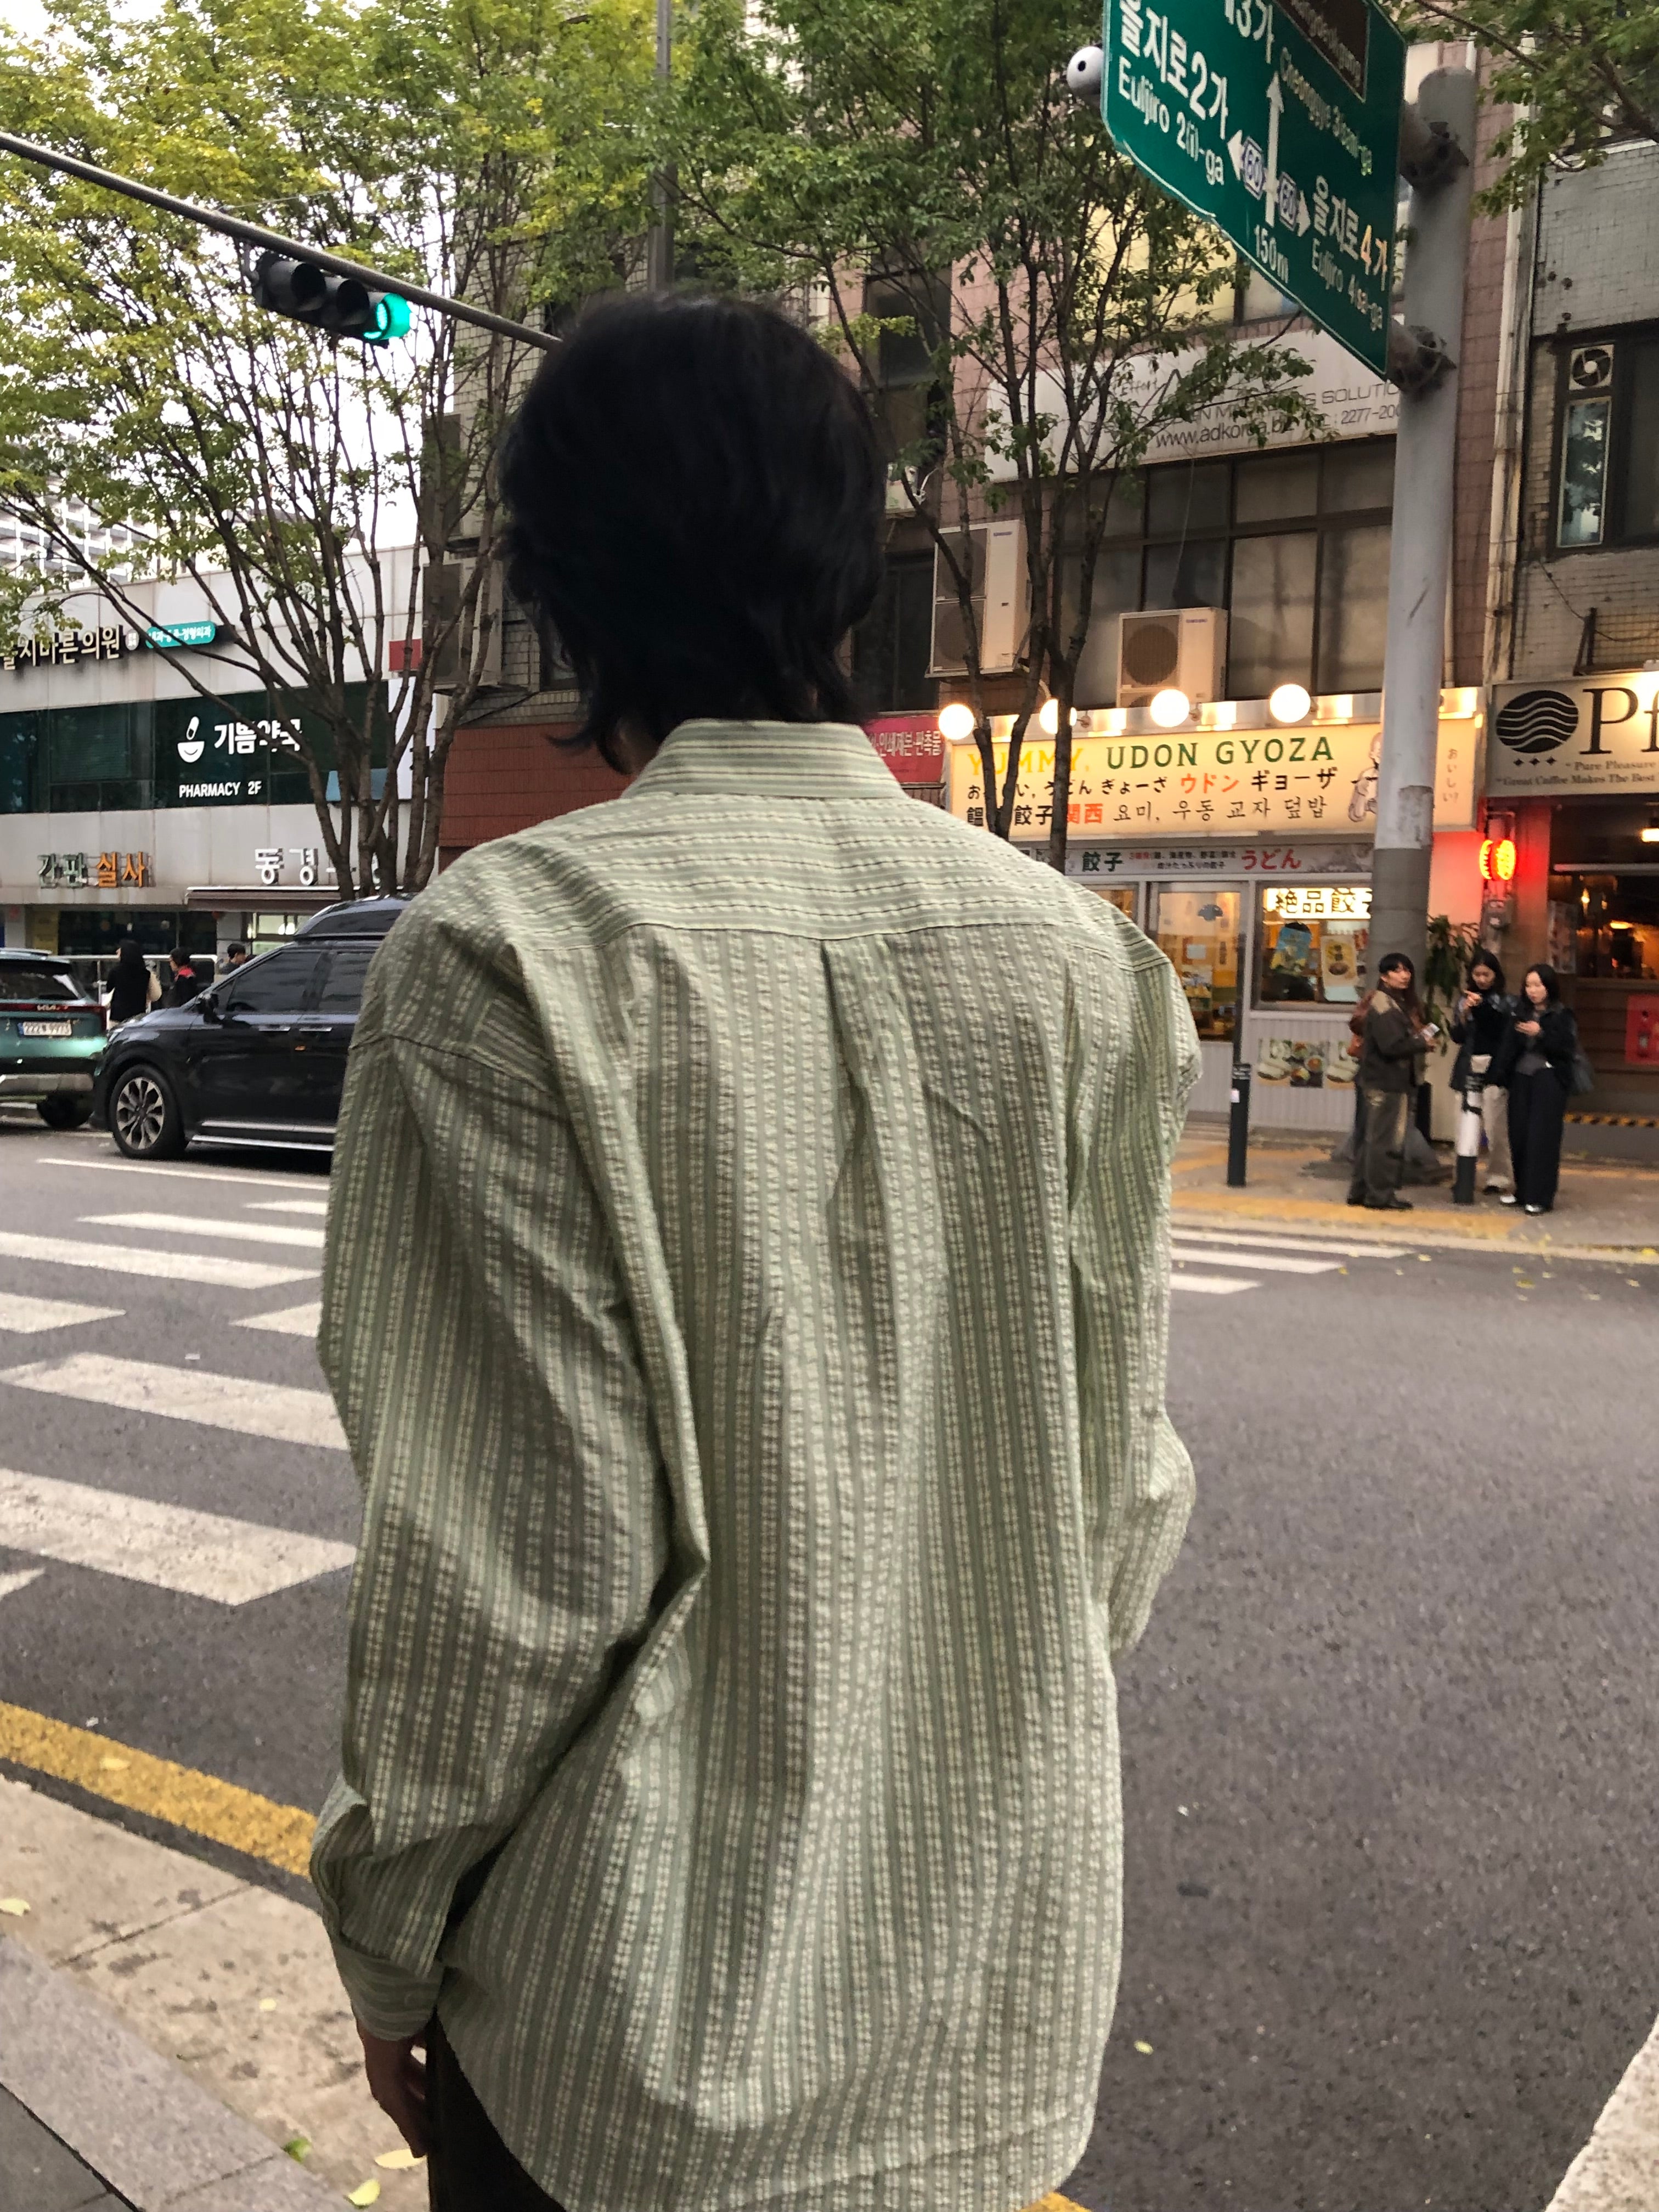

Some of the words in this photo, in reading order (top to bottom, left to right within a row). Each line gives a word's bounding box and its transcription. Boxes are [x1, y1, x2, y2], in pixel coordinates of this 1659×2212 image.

[1119, 0, 1229, 140] 을지로2가
[1312, 175, 1387, 291] 을지로4가
[1254, 224, 1289, 284] 150m
[1156, 409, 1295, 448] www.adkora.b
[1106, 742, 1198, 769] UDON
[1216, 736, 1334, 765] GYOZA
[179, 781, 241, 798] PHARMACY
[247, 780, 262, 795] 2F
[1180, 772, 1240, 793] ウドン
[1251, 766, 1338, 792] ギョーザ
[1172, 799, 1215, 821] 우동
[1227, 797, 1272, 819] 교자
[1284, 795, 1327, 819] 덮밥
[97, 851, 145, 887] 실사
[1082, 851, 1124, 872] 餃子
[1242, 848, 1302, 870] うどん
